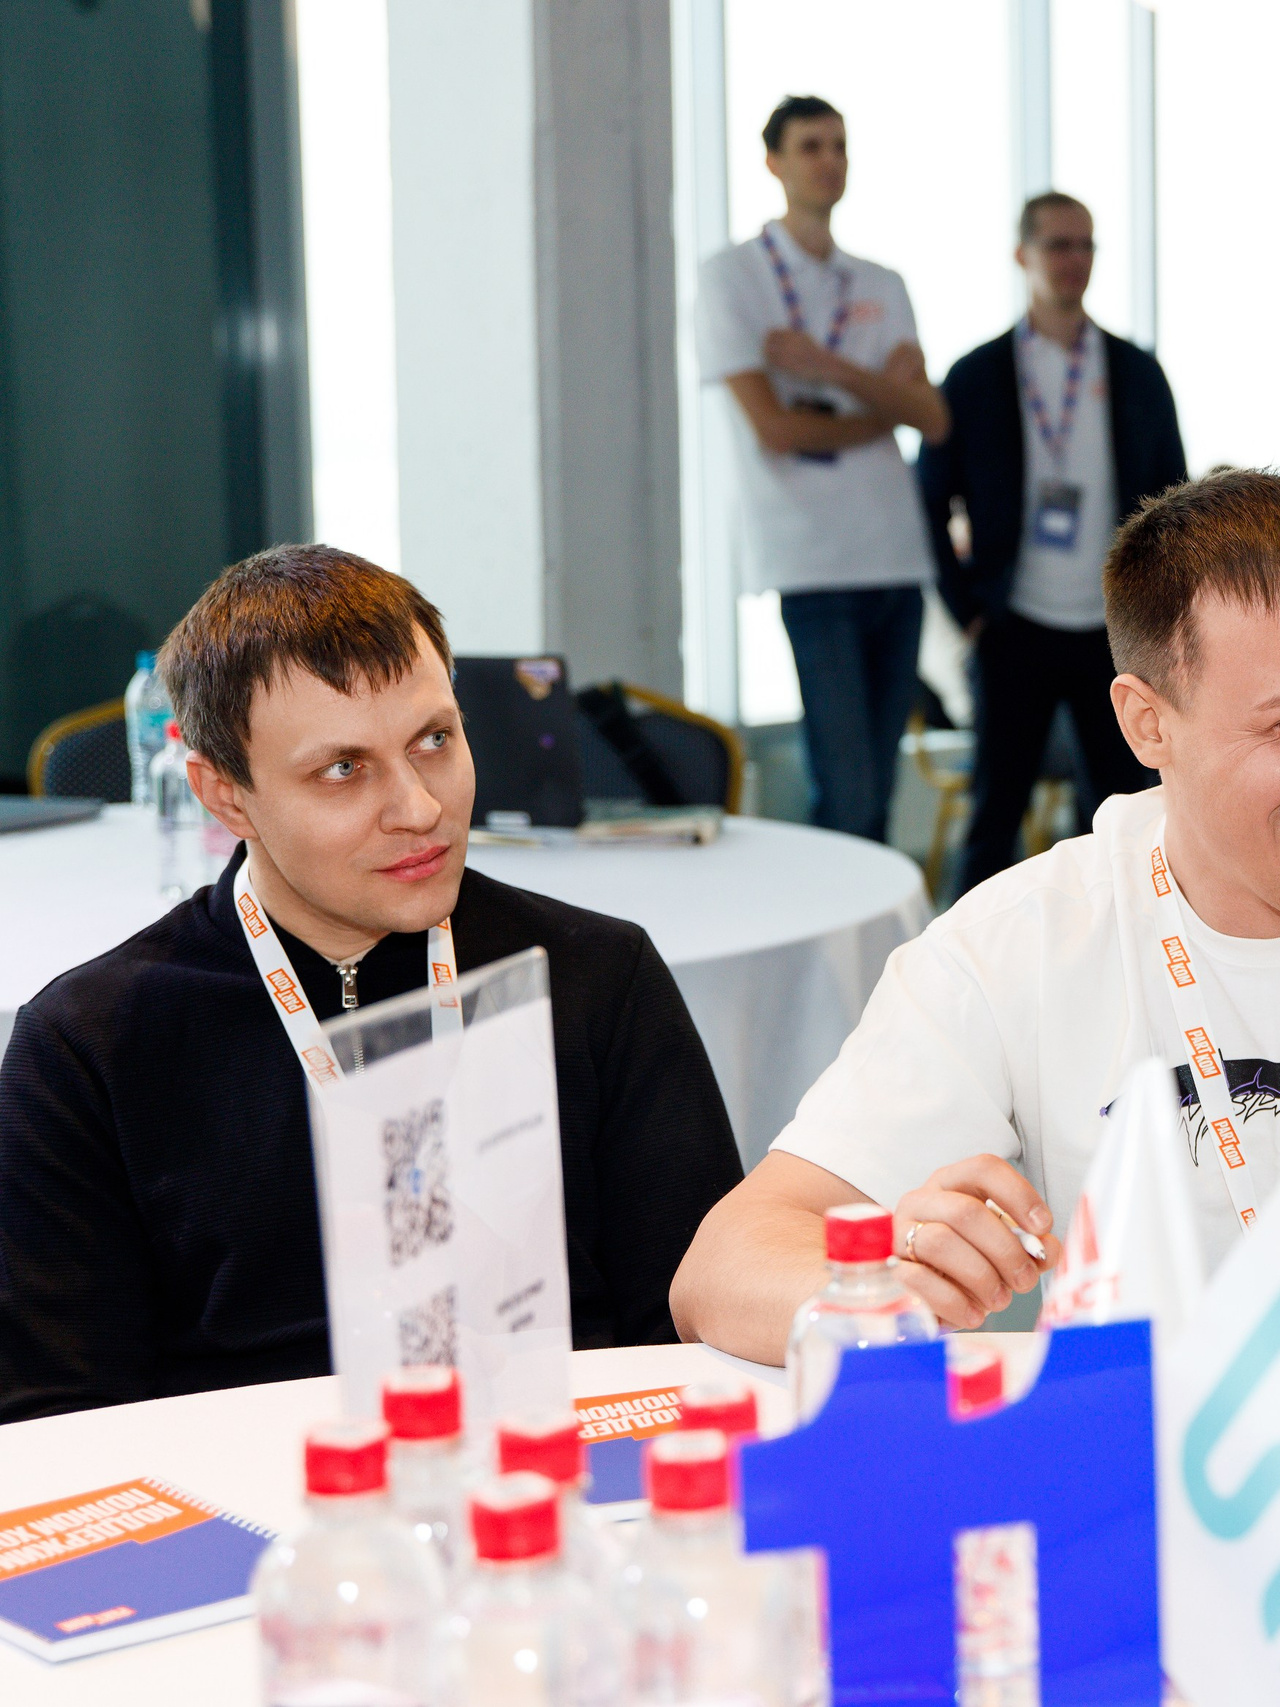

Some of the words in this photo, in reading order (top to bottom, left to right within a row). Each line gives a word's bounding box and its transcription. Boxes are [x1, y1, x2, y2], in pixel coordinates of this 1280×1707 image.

[1152, 847, 1166, 872] PART
[1152, 872, 1170, 895] KOM
[1163, 937, 1188, 963] PART
[1168, 962, 1194, 987] KOM
[1187, 1029, 1213, 1054] PART
[1193, 1053, 1219, 1077] KOM
[1213, 1119, 1238, 1144] PART
[1221, 1143, 1244, 1167] KOM
[27, 1487, 157, 1537] ПОЛНОМ
